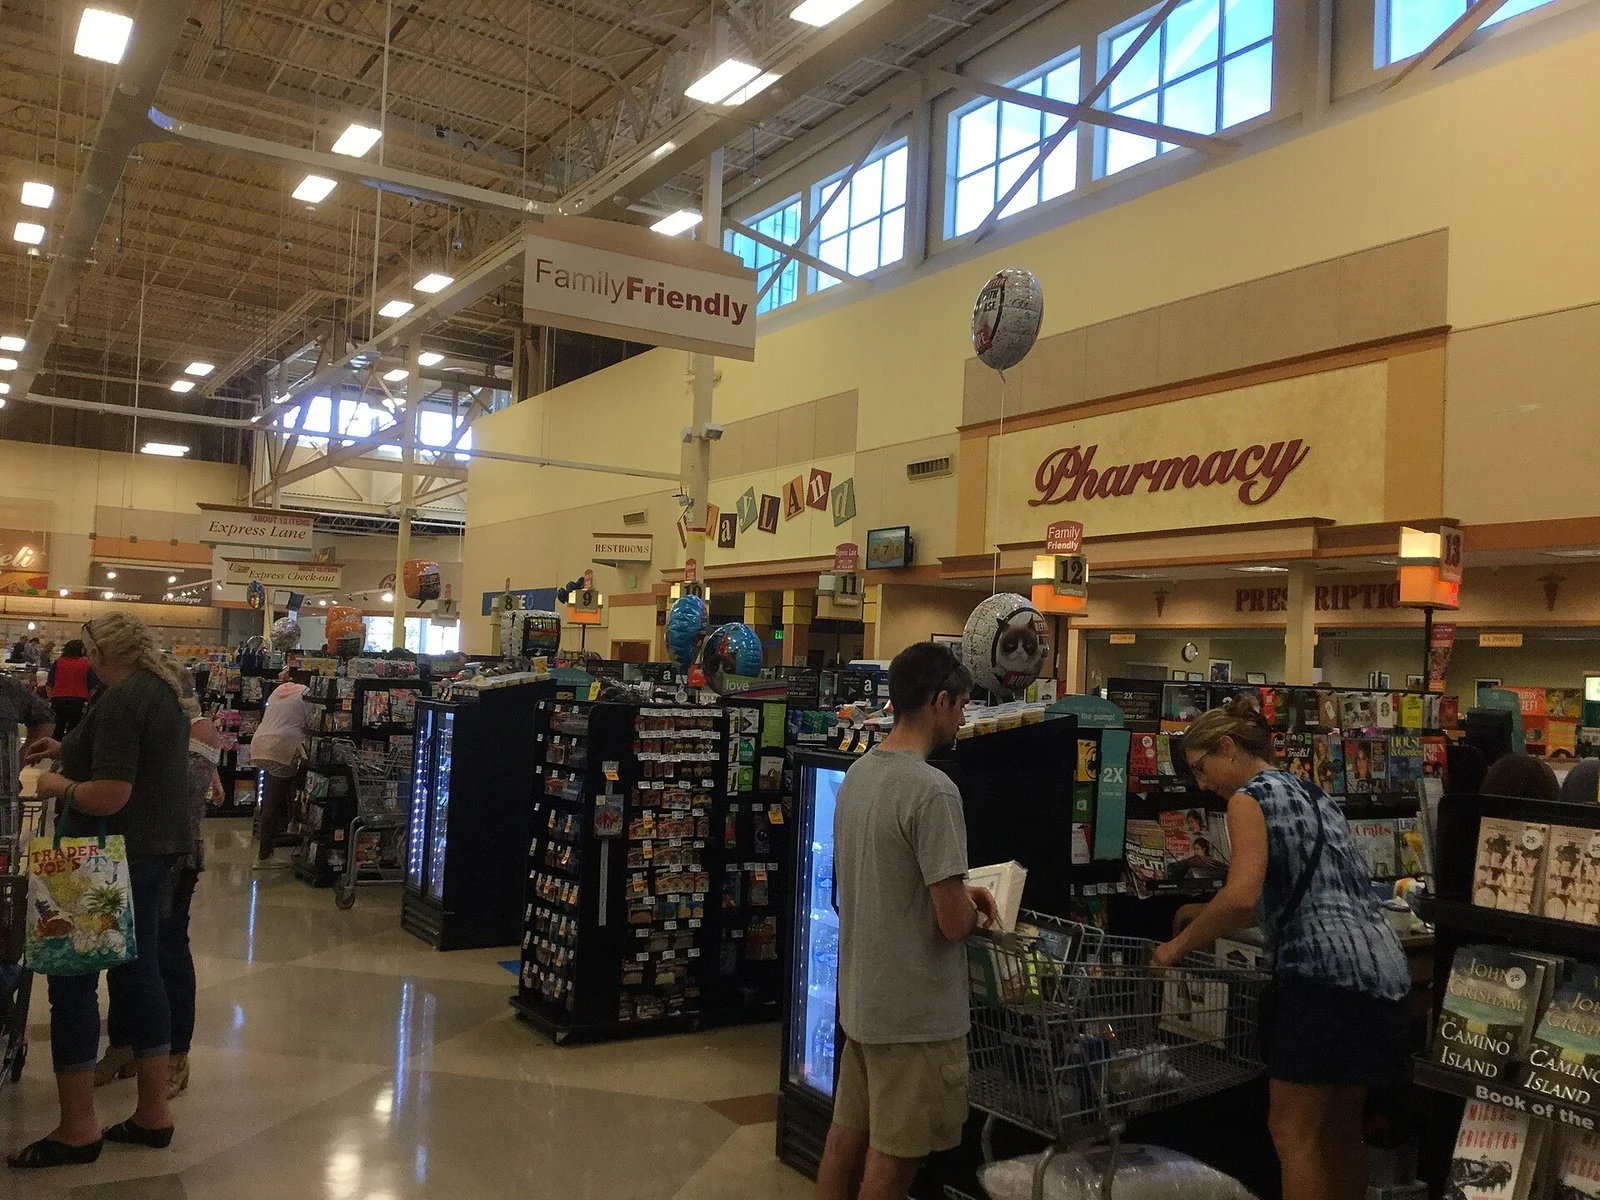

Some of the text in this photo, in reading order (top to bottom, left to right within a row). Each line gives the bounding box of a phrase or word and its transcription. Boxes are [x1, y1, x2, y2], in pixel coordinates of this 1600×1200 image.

[1028, 438, 1311, 506] Pharmacy
[680, 473, 851, 546] ayLAnd
[252, 514, 277, 524] ABOUT
[289, 517, 311, 526] ITEMS
[208, 520, 306, 540] Express Lane
[1048, 526, 1081, 540] Family
[595, 544, 649, 554] RESTROOMS
[1047, 541, 1079, 551] Friendly
[0, 546, 35, 567] eli
[248, 570, 336, 583] Express Check-out
[1059, 559, 1083, 585] 12
[840, 575, 858, 595] 11
[100, 591, 141, 601] FdMeyer
[504, 597, 513, 610] 8
[582, 592, 592, 607] 9
[1235, 582, 1399, 612] PRERIPTIO
[444, 600, 452, 612] 7
[774, 630, 784, 640] EXI
[726, 679, 750, 691] love
[1123, 691, 1134, 700] 2X
[1102, 767, 1124, 783] 2X
[1355, 823, 1392, 838] Crafts
[31, 845, 100, 864] TRADER
[33, 857, 82, 876] JOE'S
[1441, 1022, 1511, 1056] CAMINO
[1440, 1045, 1498, 1079] ISLAND
[1524, 1071, 1591, 1105] ISLAND
[1475, 1085, 1595, 1130] Book of the
